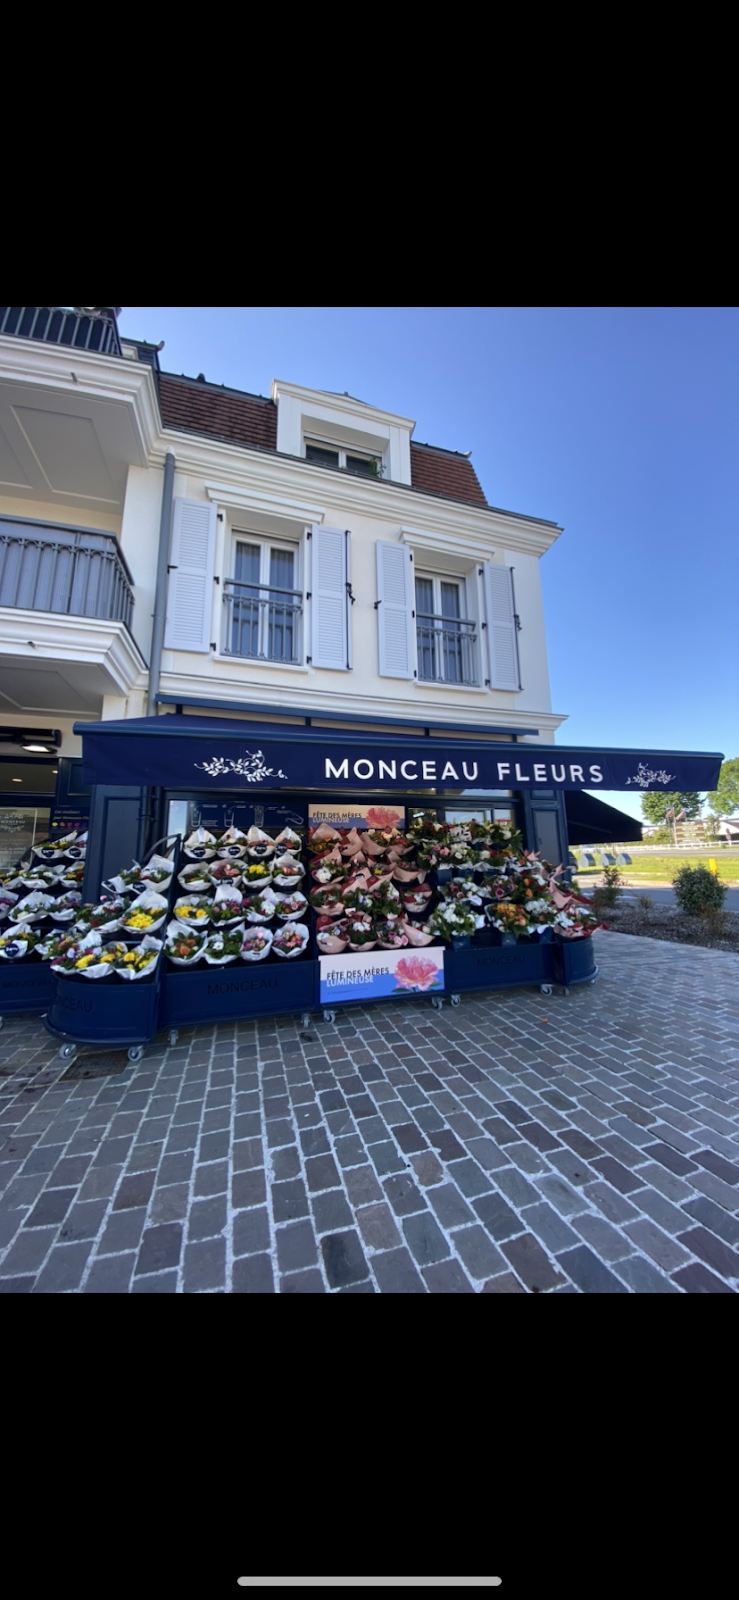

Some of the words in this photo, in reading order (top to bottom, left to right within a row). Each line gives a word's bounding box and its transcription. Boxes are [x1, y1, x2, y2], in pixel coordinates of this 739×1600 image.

[324, 758, 479, 781] MONCEAU
[497, 763, 604, 783] FLEURS
[312, 811, 326, 819] FÊTE
[341, 811, 362, 819] MÈRES
[476, 954, 526, 969] MONCEAU
[326, 970, 345, 981] FÊTE
[346, 970, 362, 979] DES
[363, 966, 390, 977] MÈRES
[2, 978, 51, 990] MONCEAU
[206, 978, 279, 995] MONCEAU
[326, 975, 374, 988] LUMINEUSE
